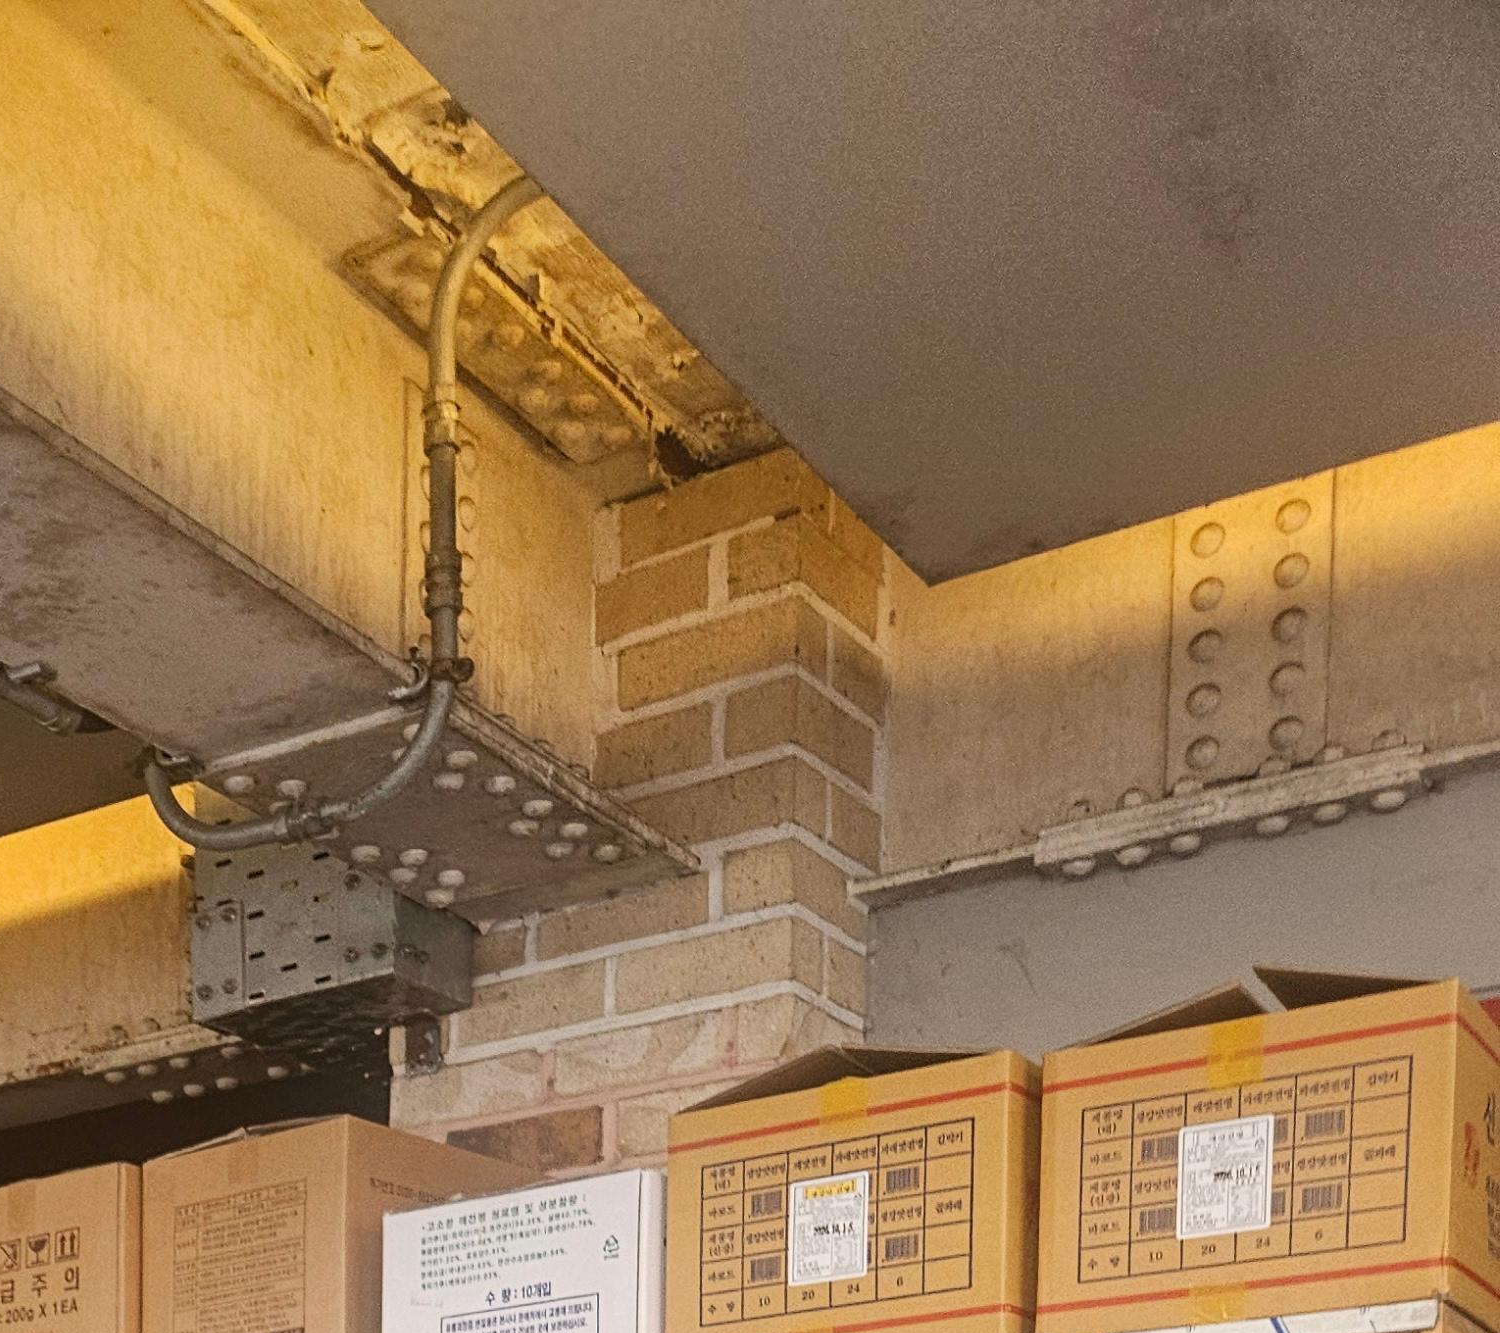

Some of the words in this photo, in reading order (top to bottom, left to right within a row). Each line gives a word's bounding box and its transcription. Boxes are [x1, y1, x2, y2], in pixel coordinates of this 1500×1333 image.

[1315, 1229, 1323, 1239] 6
[1256, 1237, 1270, 1248] 24
[1201, 1244, 1216, 1255] 20
[1149, 1251, 1163, 1262] 10
[897, 1277, 904, 1287] 6
[847, 1283, 860, 1294] 24
[802, 1290, 815, 1300] 20
[758, 1296, 771, 1307] 10
